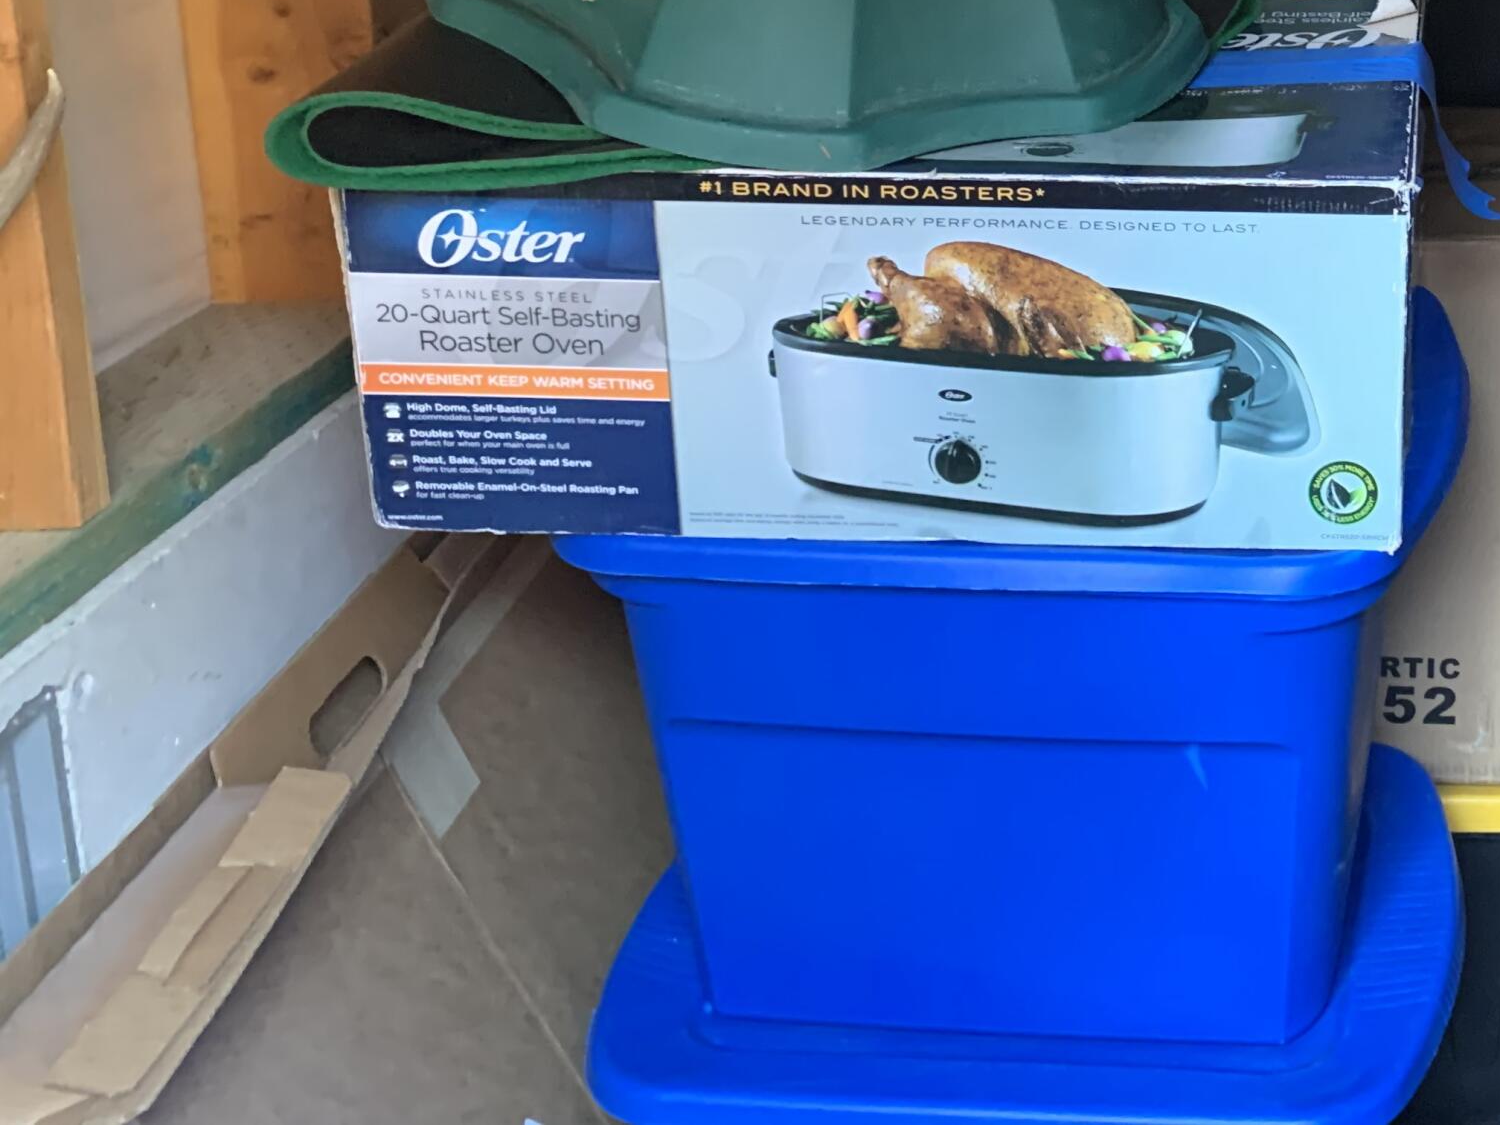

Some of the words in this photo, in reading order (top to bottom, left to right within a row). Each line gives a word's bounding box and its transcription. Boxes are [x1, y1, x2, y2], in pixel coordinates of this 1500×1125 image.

[1271, 10, 1374, 19] elf-Basting
[1220, 27, 1382, 52] Oste
[699, 181, 721, 195] #1
[732, 181, 833, 198] BRAND
[842, 184, 870, 198] IN
[800, 215, 916, 228] LEGENDARY
[1079, 220, 1176, 232] DESIGNED
[1182, 222, 1205, 233] TO
[417, 208, 586, 268] Oster
[421, 288, 525, 303] STAINLESS
[535, 291, 593, 304] STEEL
[375, 303, 491, 326] 20-Quart
[498, 306, 641, 332] Self-Basting
[419, 330, 523, 353] Roaster
[532, 332, 604, 356] Oven
[378, 372, 484, 387] CONVENIENT
[488, 374, 529, 387] KEEP
[533, 375, 584, 389] WARM
[587, 377, 655, 392] SETTING
[406, 403, 432, 413] High
[435, 403, 470, 414] Dome,
[472, 403, 537, 415] Self-Basting
[540, 405, 557, 414] Lid
[410, 428, 454, 438] Doubles
[456, 429, 481, 438] Your
[483, 430, 512, 439] Oven
[514, 431, 548, 441] Space
[413, 455, 446, 465] Roast,
[449, 455, 478, 466] Bake,
[480, 456, 506, 466] Slow
[508, 457, 537, 466] Cook
[539, 457, 560, 467] and
[562, 458, 593, 467] Serve
[415, 480, 475, 491] Removable
[477, 481, 567, 493] Enamel-On-Steel
[569, 484, 616, 496] Roasting
[618, 485, 639, 494] Pan
[1380, 657, 1461, 680] RTIC
[1382, 686, 1457, 725] 52
